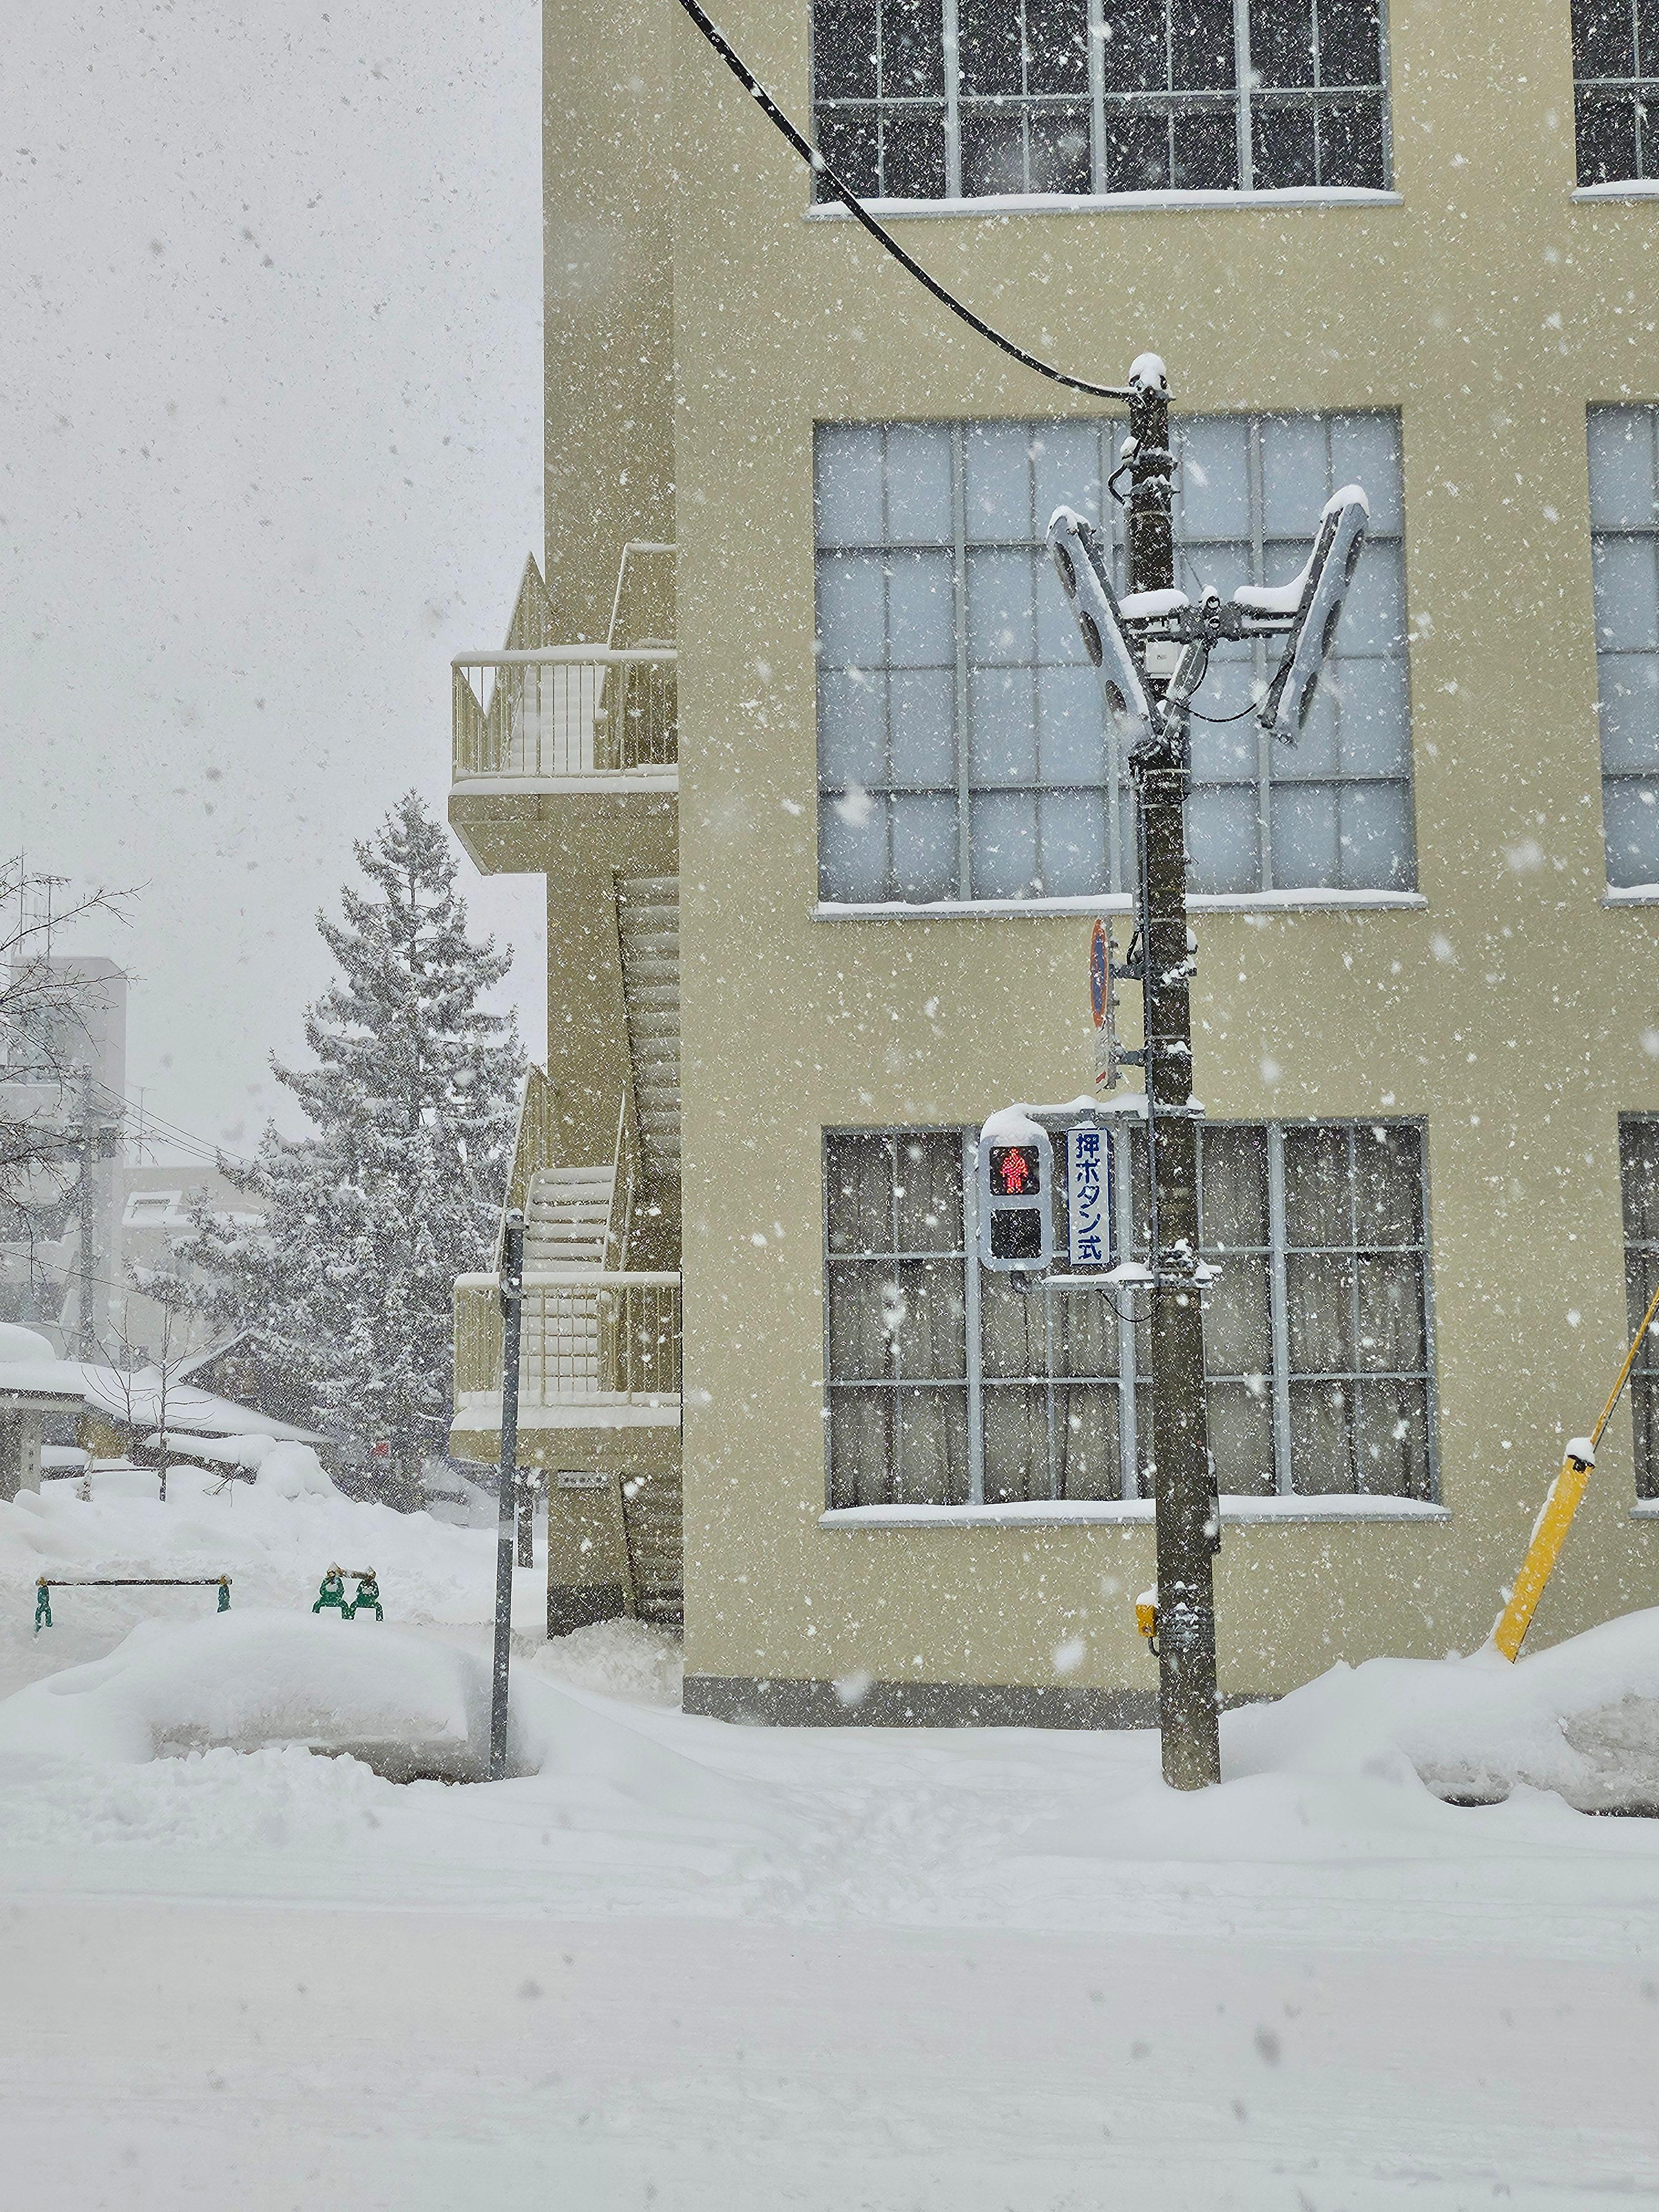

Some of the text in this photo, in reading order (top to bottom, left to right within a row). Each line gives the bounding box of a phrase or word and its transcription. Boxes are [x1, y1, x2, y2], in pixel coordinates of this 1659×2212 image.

[1076, 1133, 1102, 1260] 押ボタン式
